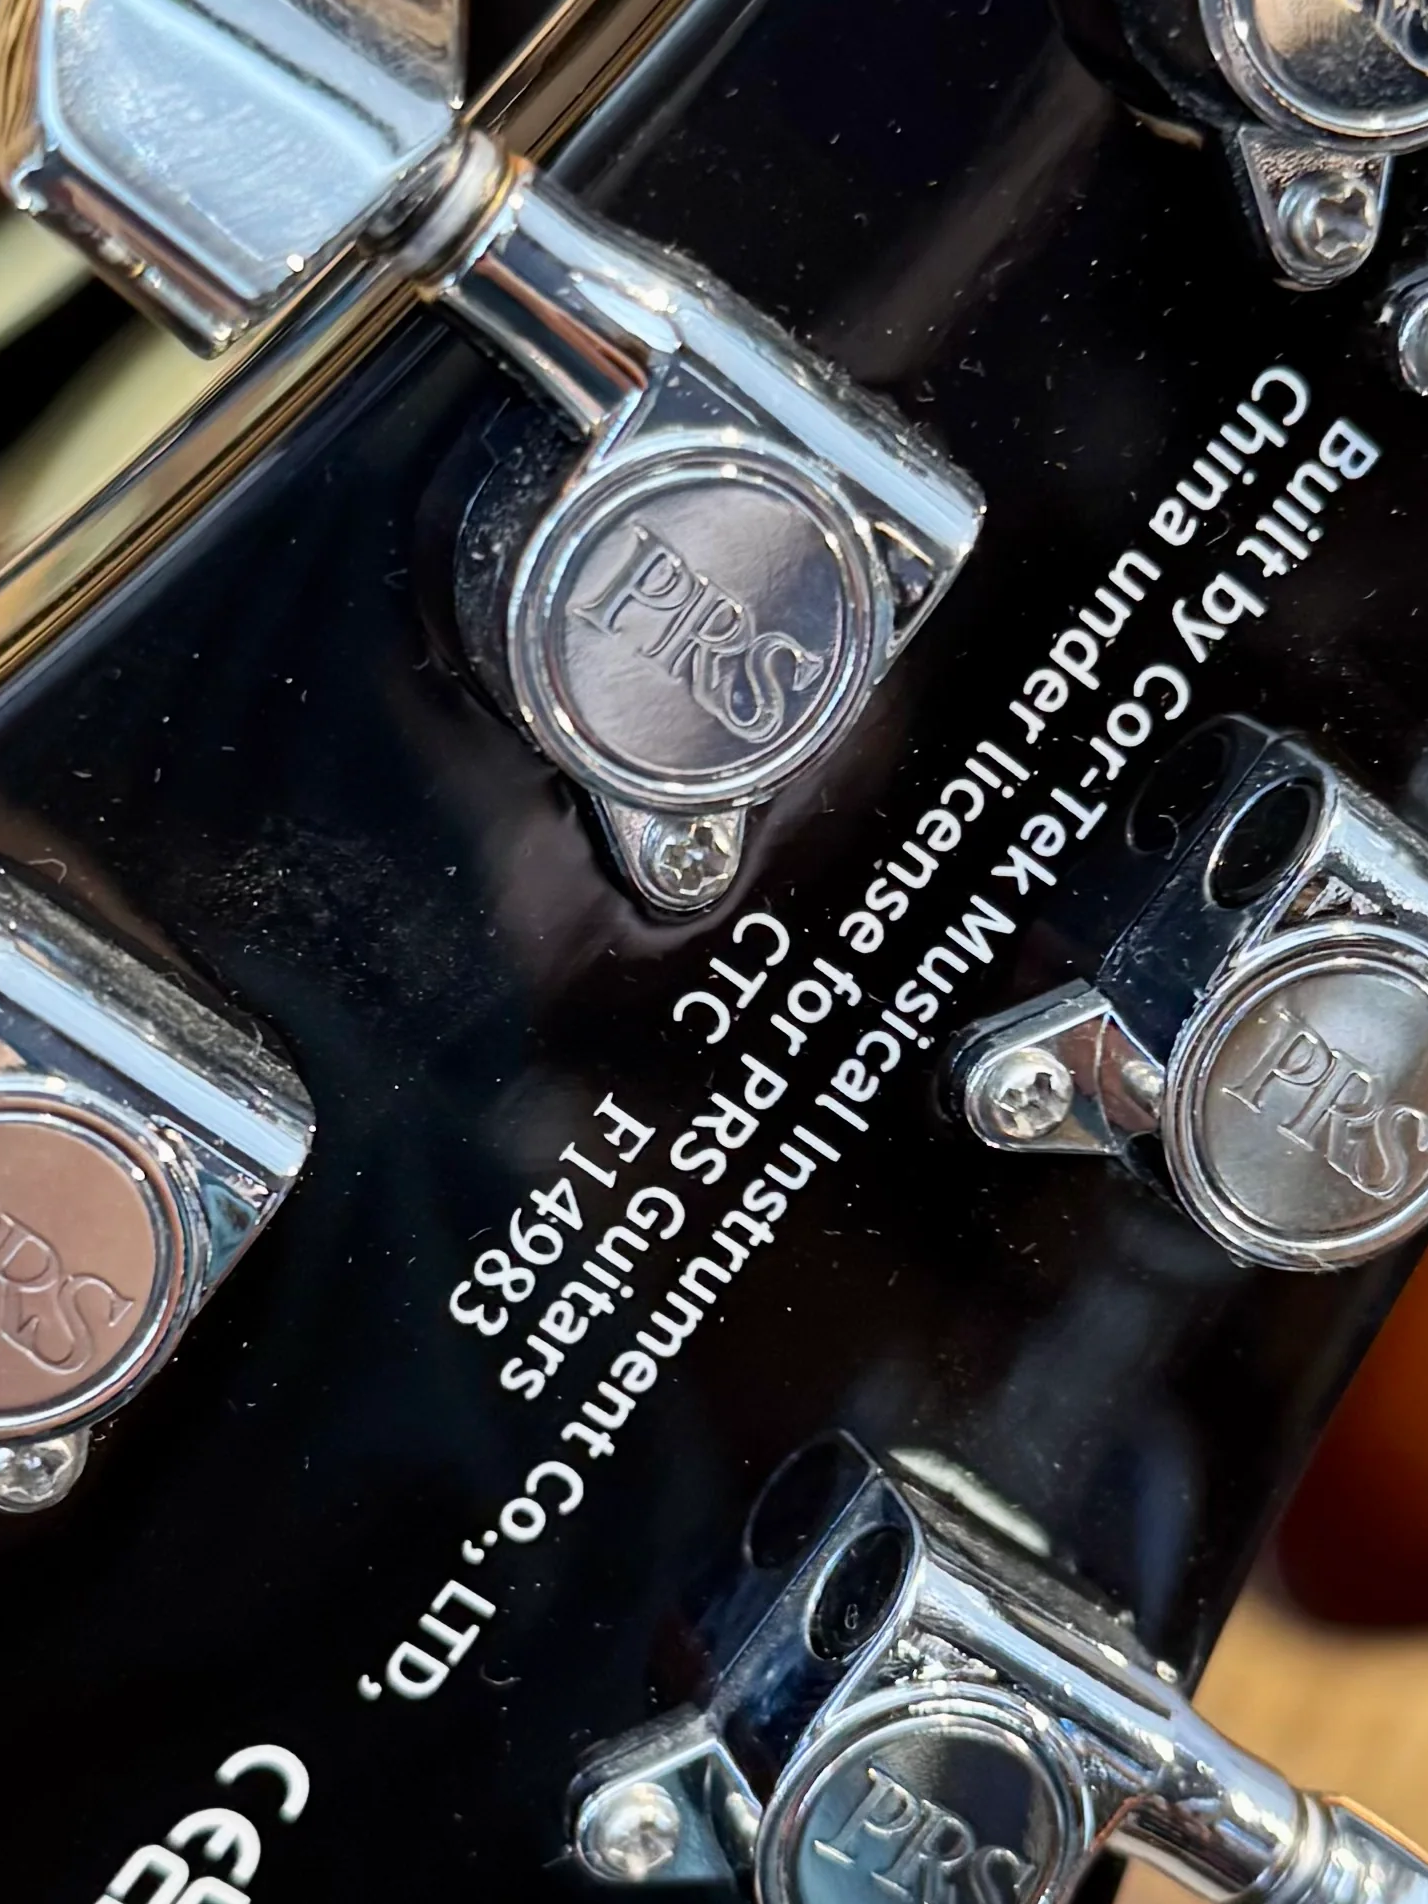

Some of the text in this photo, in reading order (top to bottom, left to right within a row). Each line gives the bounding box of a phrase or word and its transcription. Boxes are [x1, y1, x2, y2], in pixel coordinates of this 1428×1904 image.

[1236, 418, 1383, 577] Built
[567, 521, 824, 743] PRS
[1172, 574, 1265, 663] by
[500, 365, 1311, 1400] China under license for PRS Guitars
[992, 665, 1191, 895] Cor-Tek
[450, 912, 790, 1336] CTC F14983
[814, 895, 1016, 1131] Musical
[561, 1125, 841, 1458] Instrument
[462, 1461, 584, 1564] Co.,
